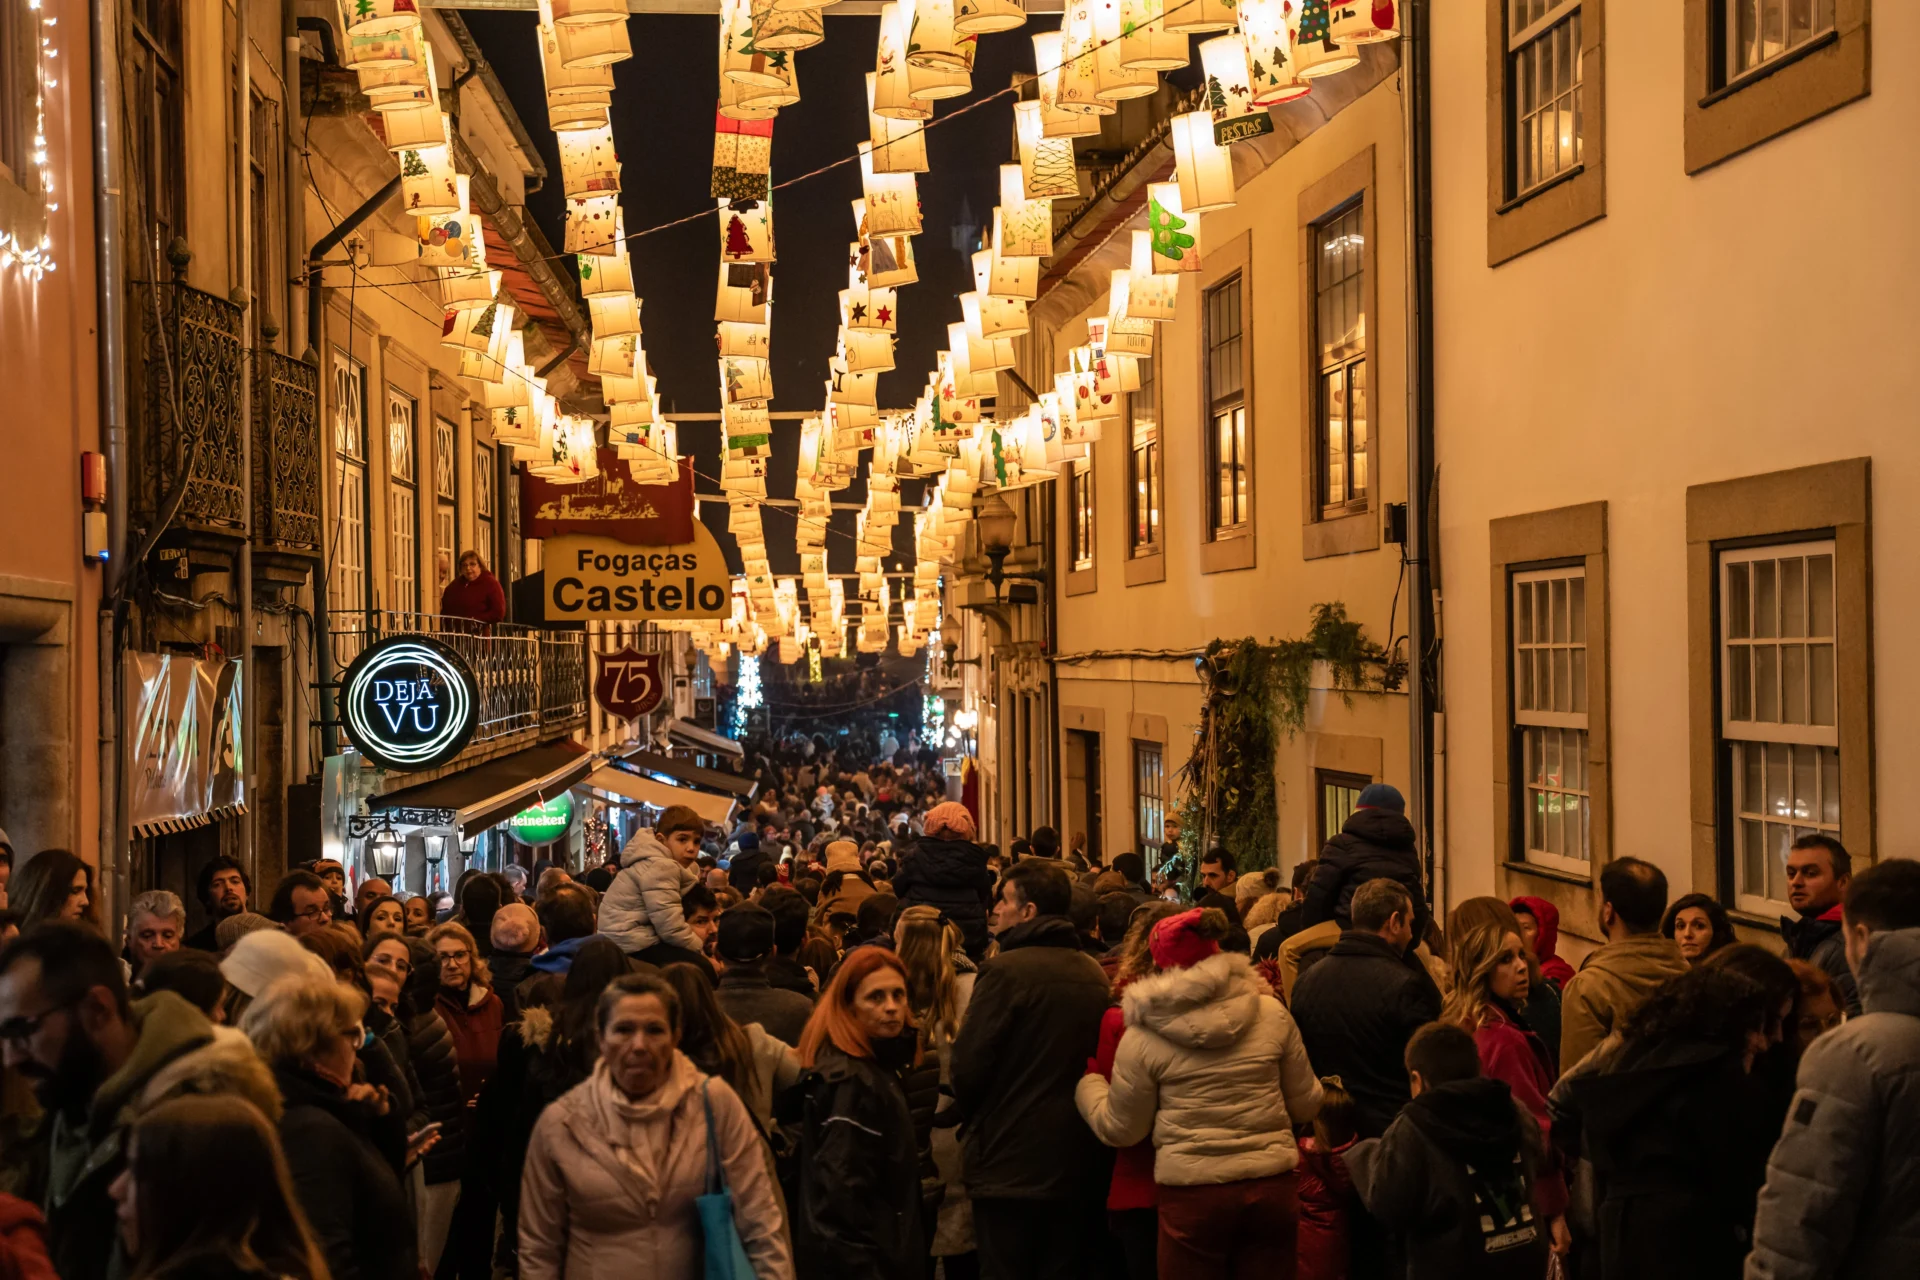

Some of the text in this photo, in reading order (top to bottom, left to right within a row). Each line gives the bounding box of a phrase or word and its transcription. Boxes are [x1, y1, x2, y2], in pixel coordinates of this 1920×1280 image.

[1221, 118, 1262, 142] FESTAS
[578, 550, 697, 577] Fogaças
[553, 577, 725, 612] Castelo
[605, 659, 651, 703] 75
[378, 703, 439, 734] VU
